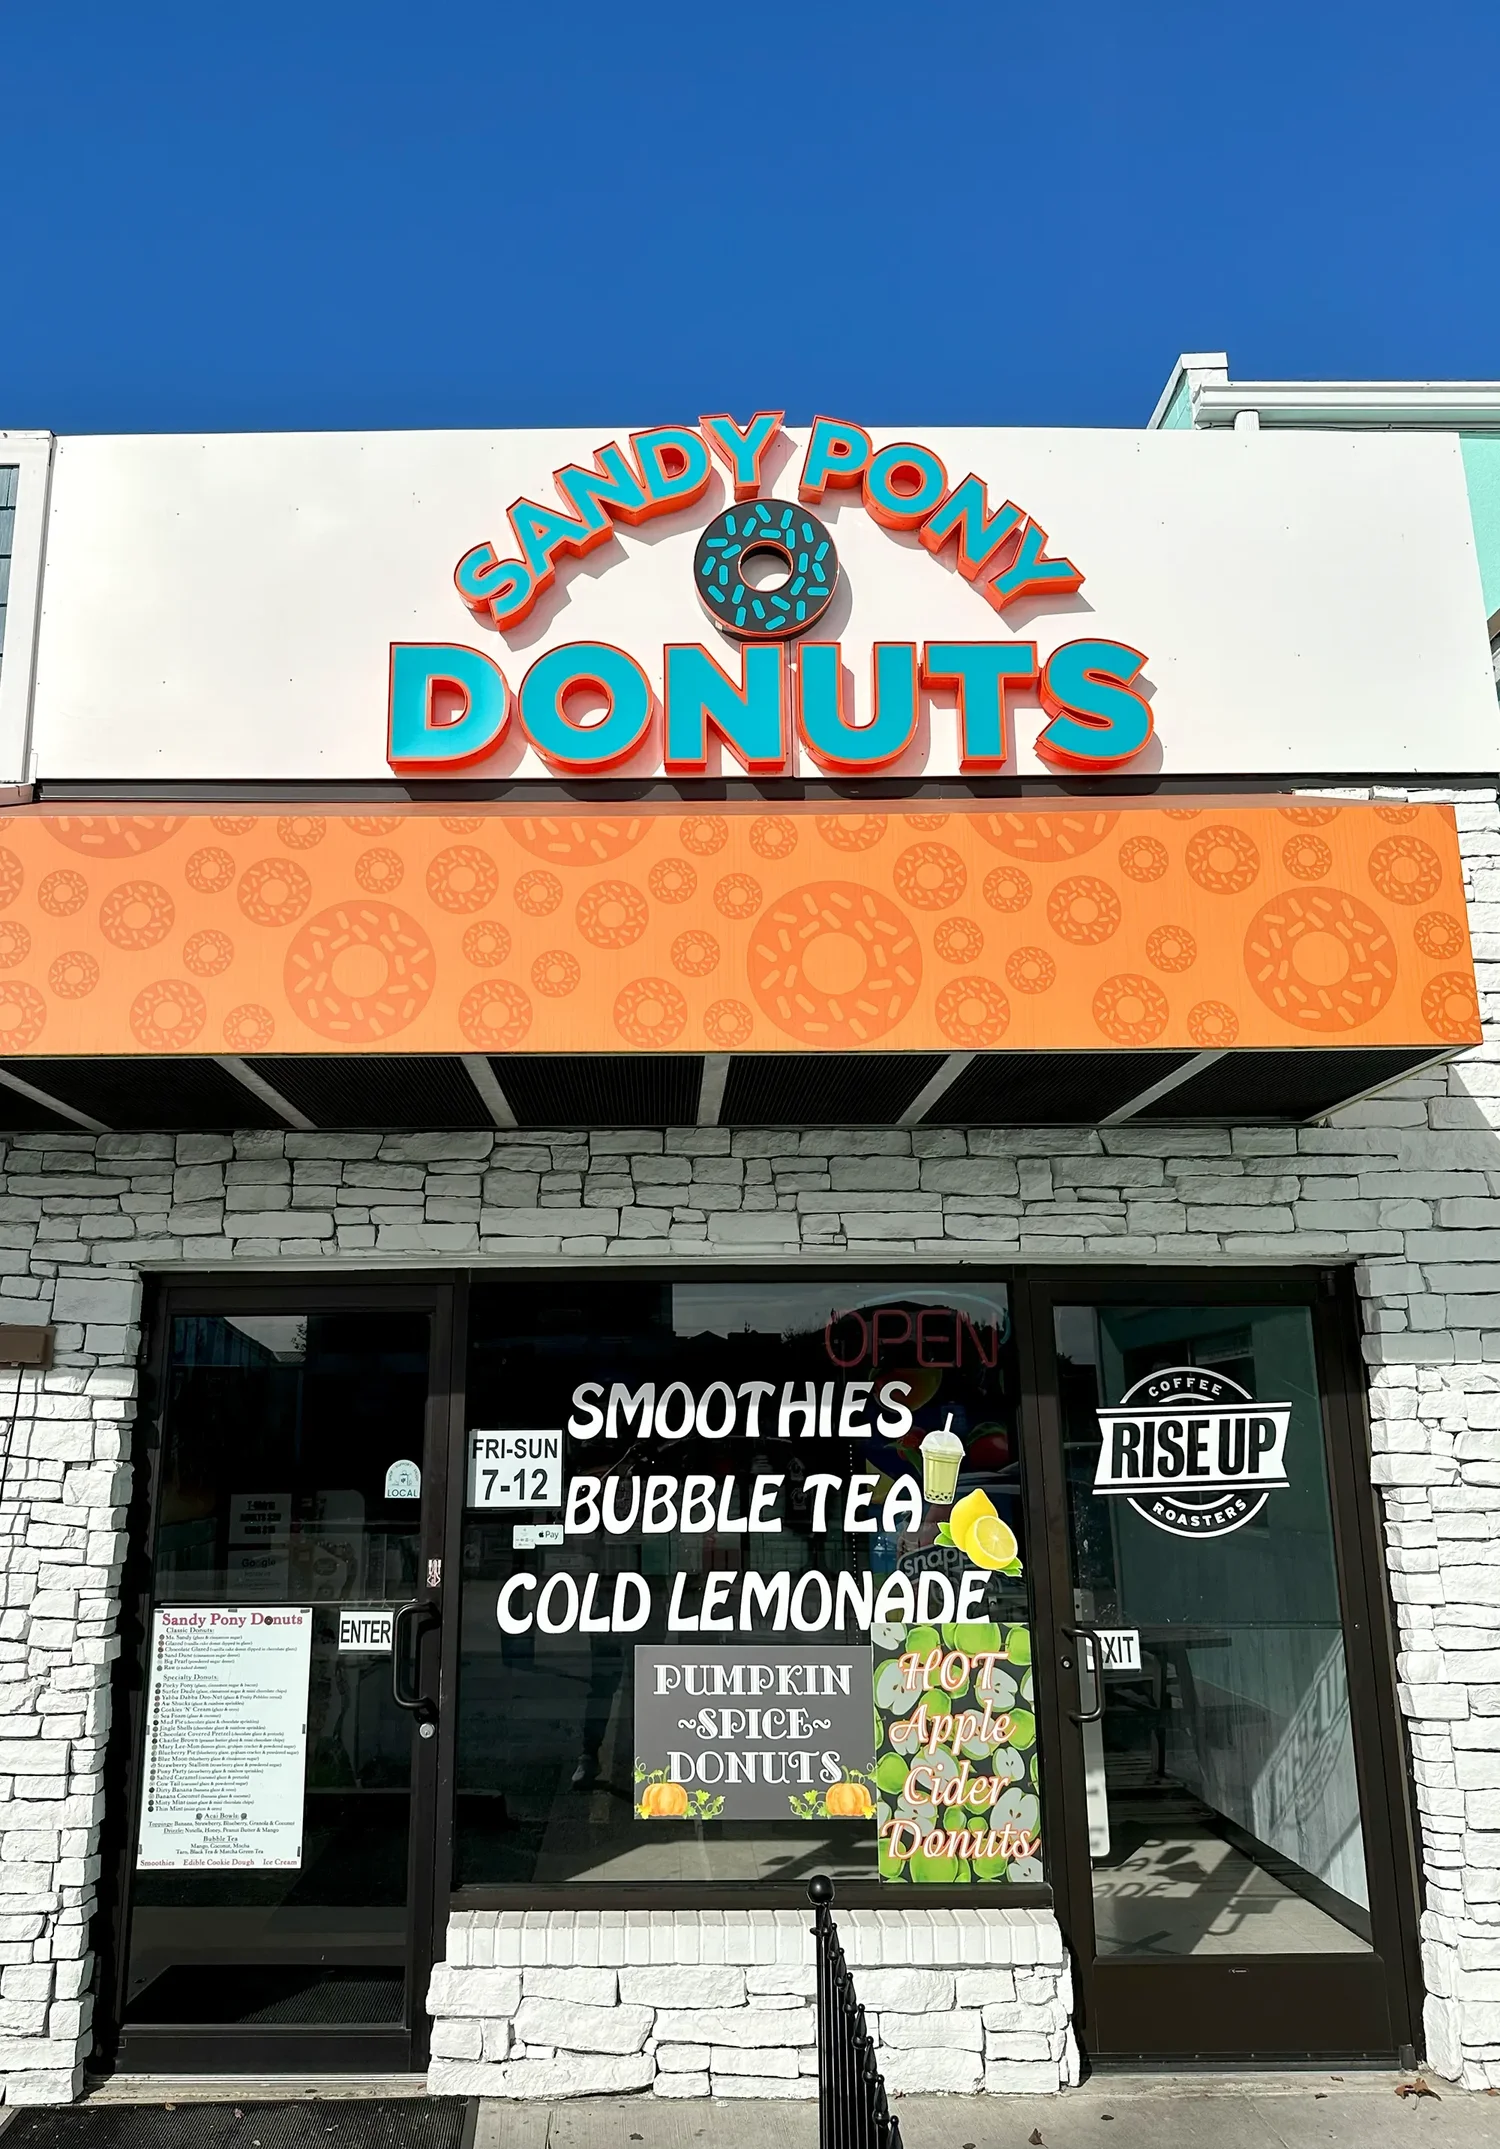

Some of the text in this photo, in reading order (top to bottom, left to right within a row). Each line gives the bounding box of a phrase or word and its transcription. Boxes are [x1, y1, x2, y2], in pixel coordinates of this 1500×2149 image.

[454, 410, 1085, 631] SANDY PONY
[387, 638, 1155, 774] DONUTS
[824, 1308, 999, 1369] OPEN
[1148, 1377, 1223, 1398] COFFEE
[567, 1380, 914, 1439] SMOOTHIES
[472, 1438, 558, 1459] FRI-SUN
[1111, 1417, 1277, 1479] RISE UP
[387, 1488, 418, 1498] LOCAL
[482, 1468, 548, 1500] 7-12
[564, 1473, 922, 1535] BUBBLE TEA
[1152, 1498, 1248, 1527] ROASTERS
[545, 1530, 560, 1540] Pay
[496, 1571, 651, 1635] COLD
[667, 1570, 992, 1632] LEMONADE
[162, 1613, 303, 1628] Sandy Pony Donuts
[341, 1620, 391, 1643] ENTER
[1095, 1636, 1134, 1664] XIT
[653, 1664, 853, 1696] PUMPKIN
[898, 1648, 1009, 1692] HOT
[888, 1699, 1017, 1756] Apple
[666, 1750, 843, 1784] DONUTS
[902, 1759, 1011, 1806] Cider
[881, 1817, 1041, 1860] Donuts
[232, 1859, 254, 1867] Dough
